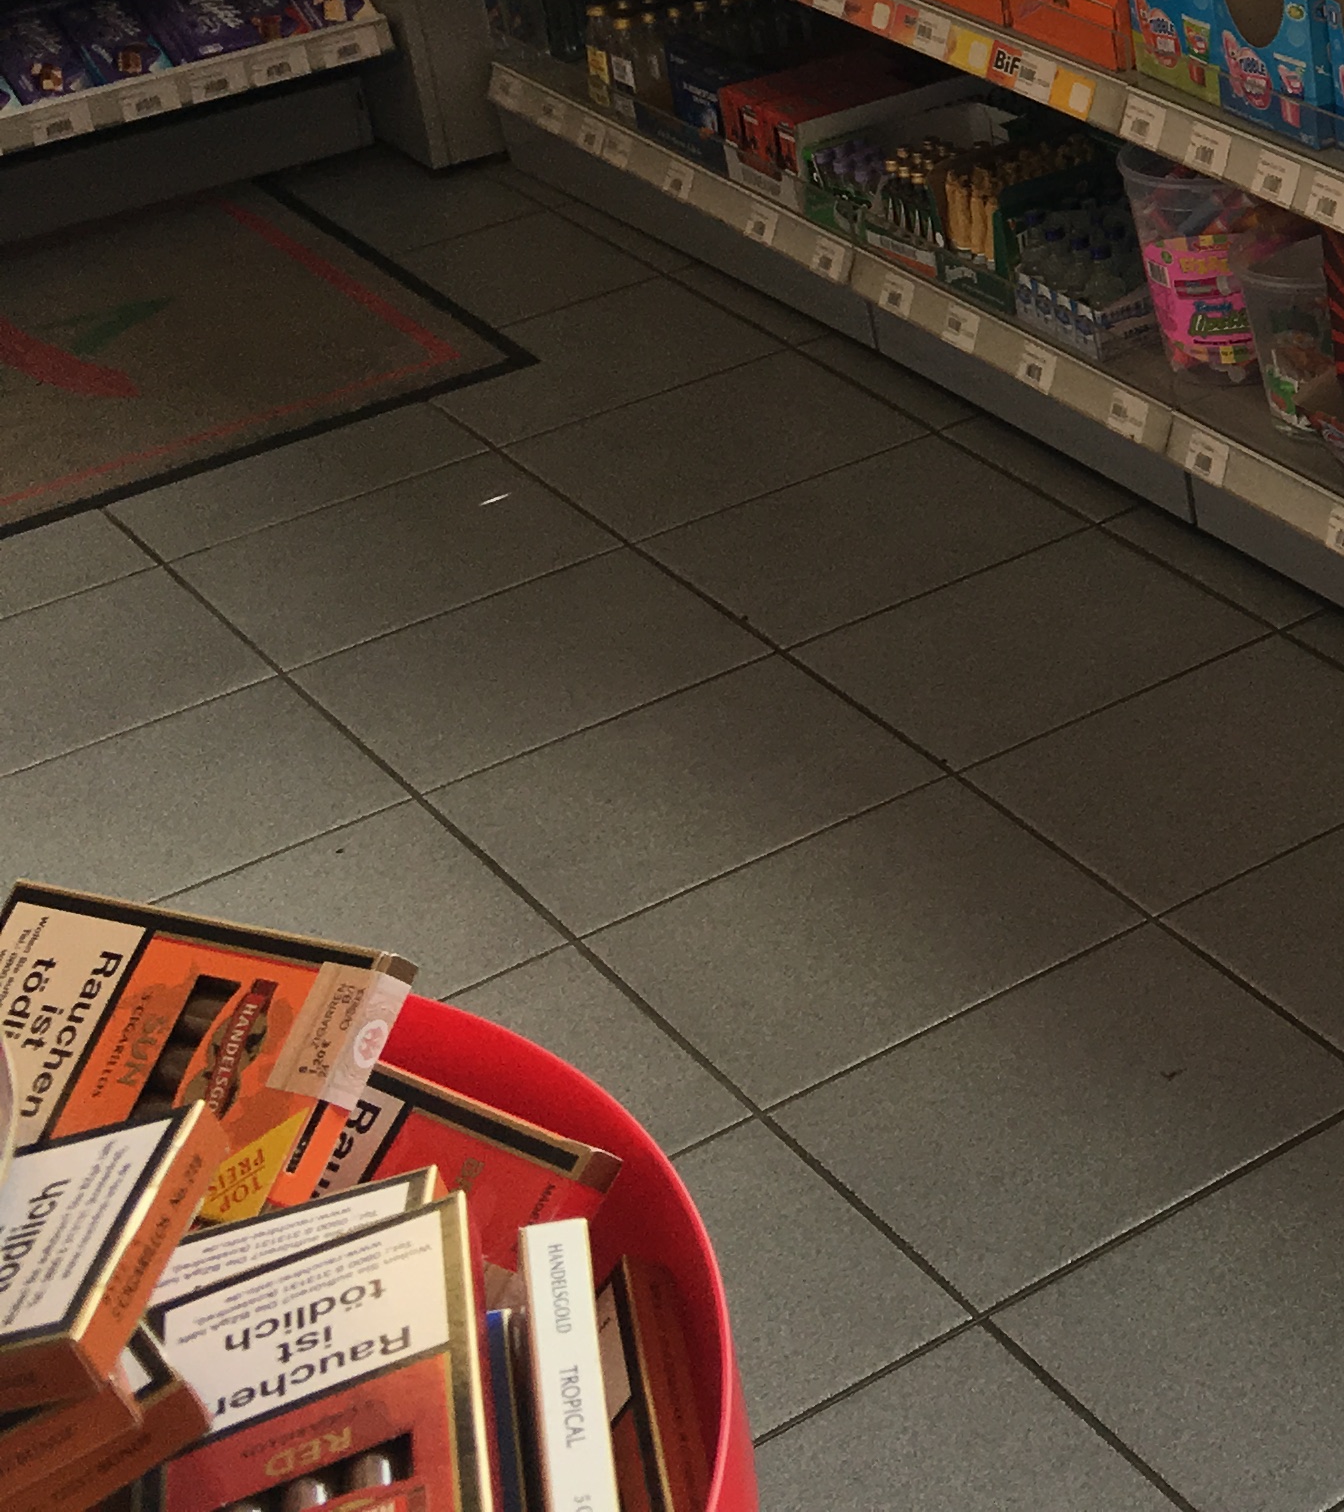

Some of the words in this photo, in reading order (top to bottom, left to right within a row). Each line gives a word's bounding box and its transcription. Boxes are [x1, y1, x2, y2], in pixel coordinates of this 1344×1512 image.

[20, 950, 123, 1119] Rauchen
[25, 1003, 65, 1051] ist
[225, 1279, 388, 1352] tödlich
[546, 1242, 573, 1335] HANDELSGOLD
[277, 1327, 334, 1365] ist
[556, 1363, 587, 1449] TROPICAL
[264, 1425, 353, 1478] RED
